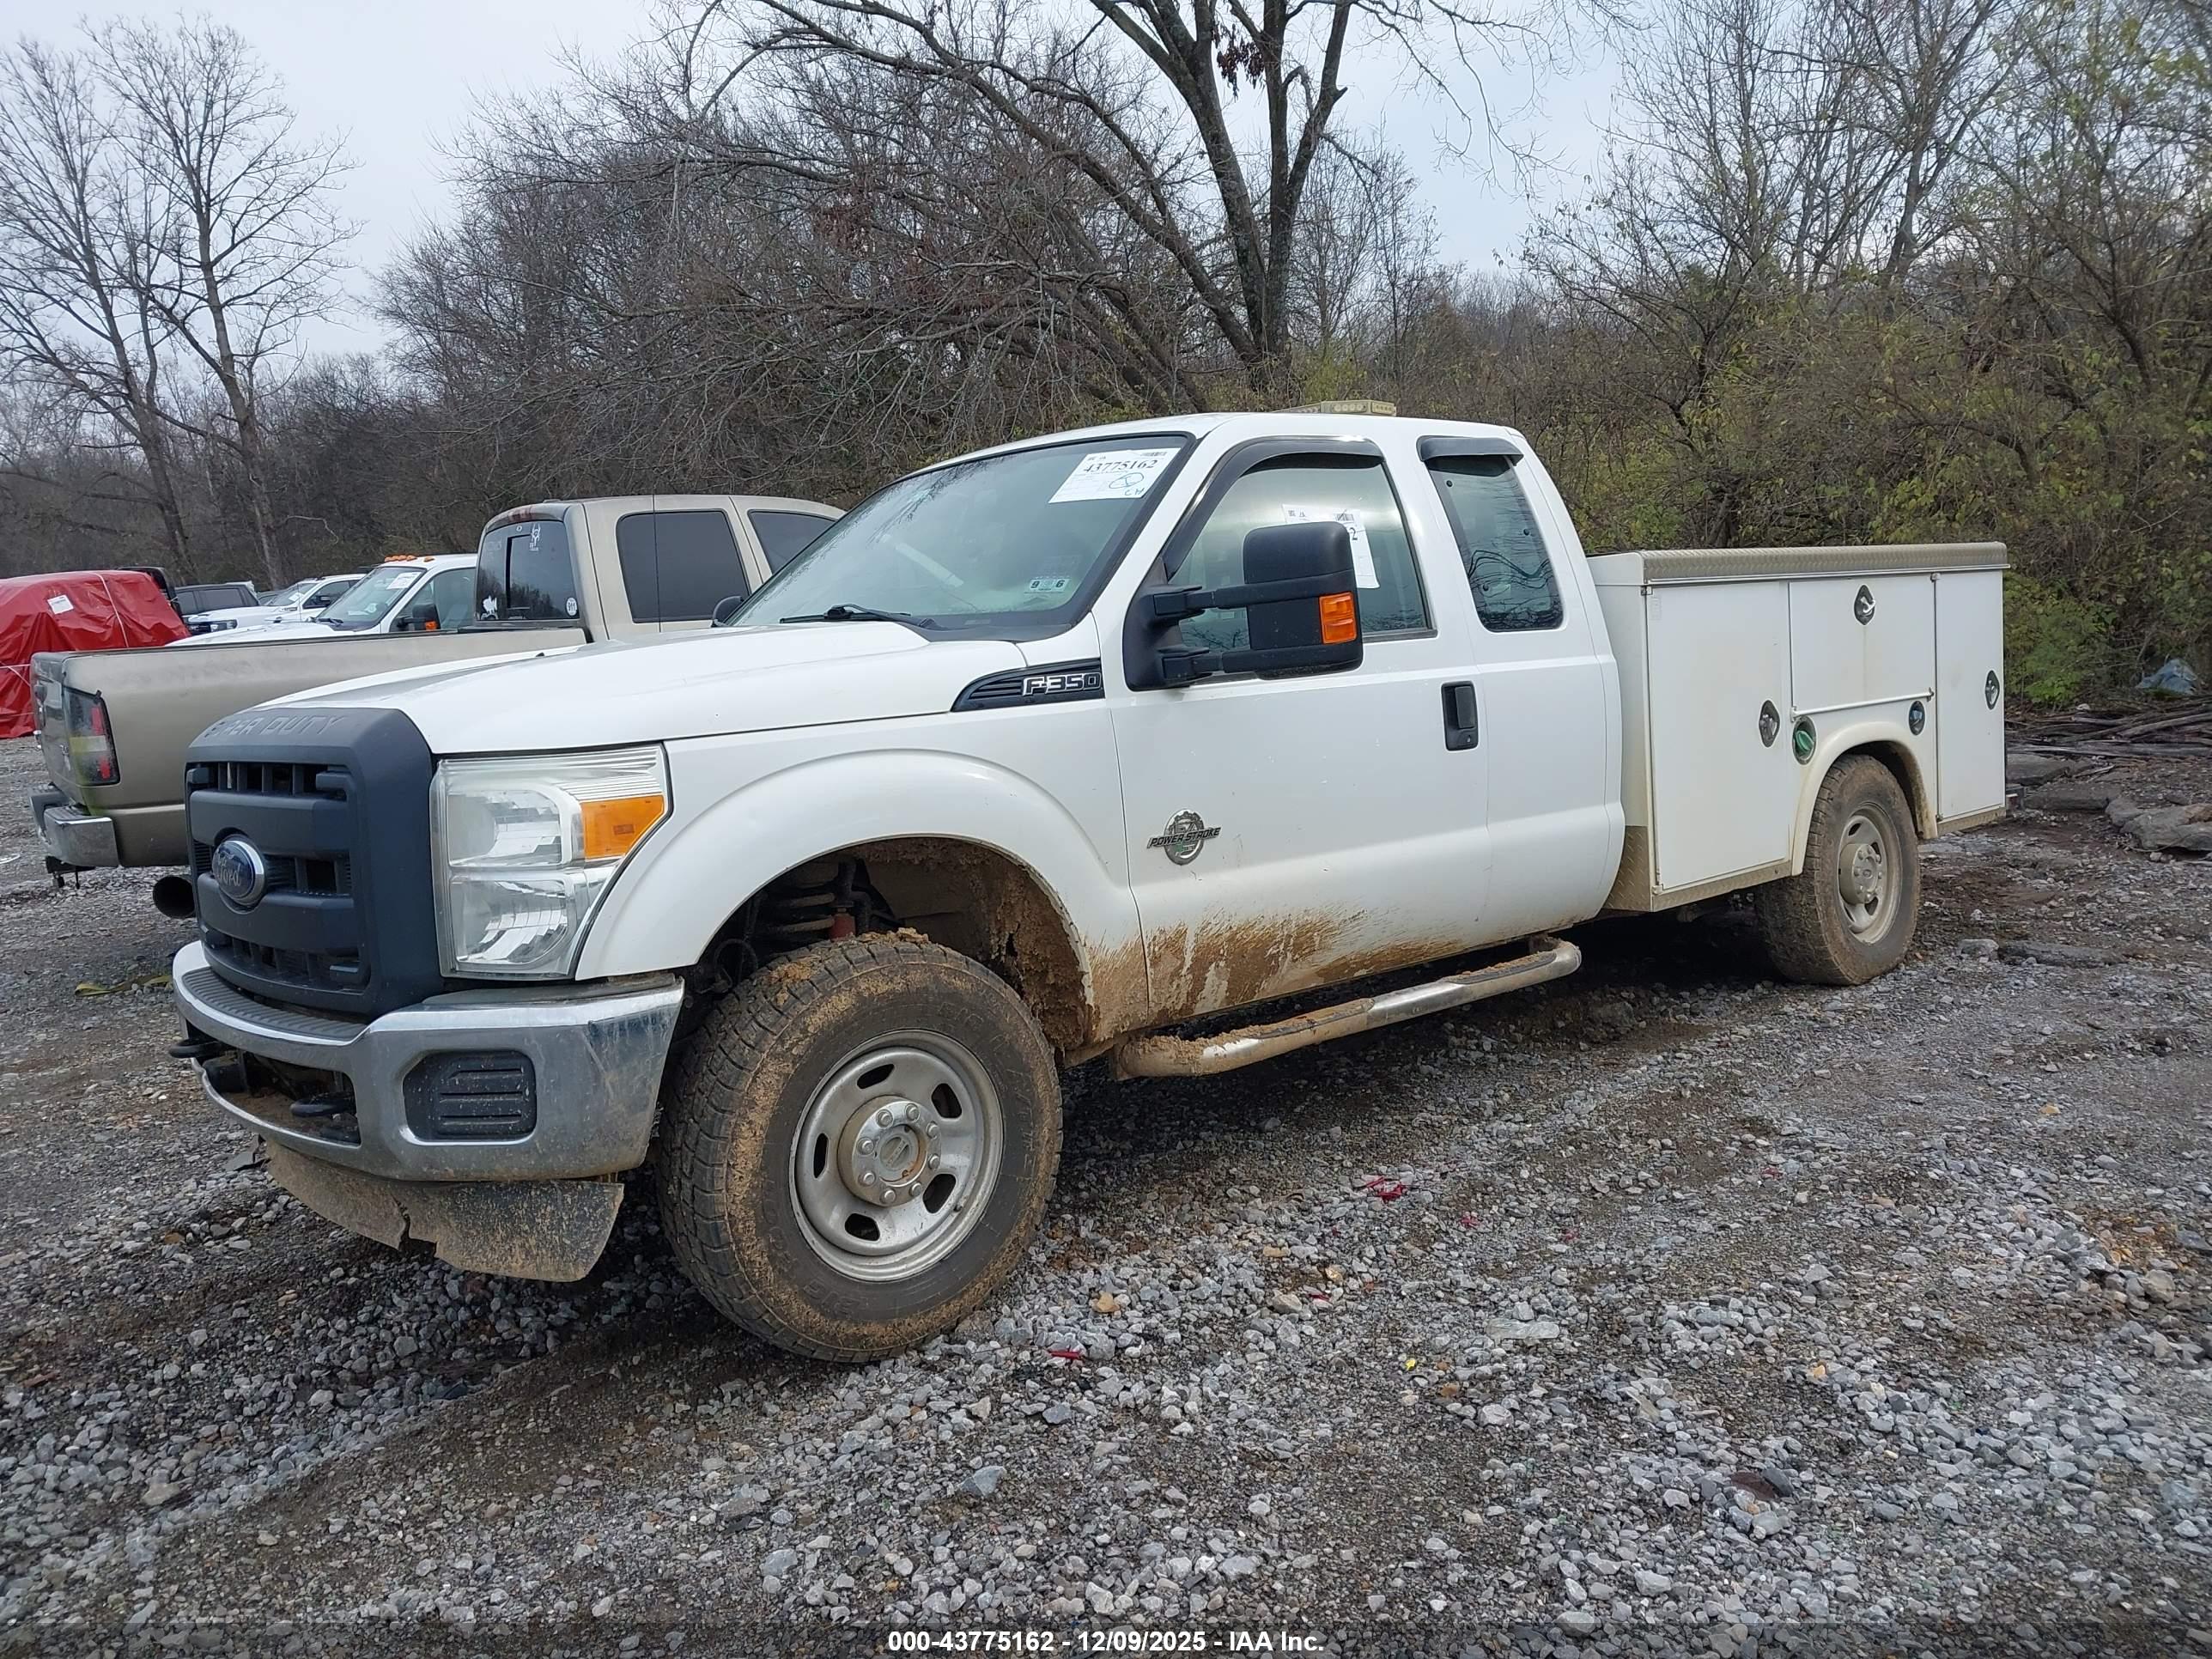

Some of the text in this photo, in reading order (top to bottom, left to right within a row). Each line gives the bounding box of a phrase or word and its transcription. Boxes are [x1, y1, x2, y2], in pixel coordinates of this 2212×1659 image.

[1084, 459, 1158, 472] 43775162
[1055, 579, 1066, 588] 6
[1023, 672, 1102, 696] F-350
[259, 714, 347, 736] DUTY
[1150, 827, 1221, 846] POWER STROKE
